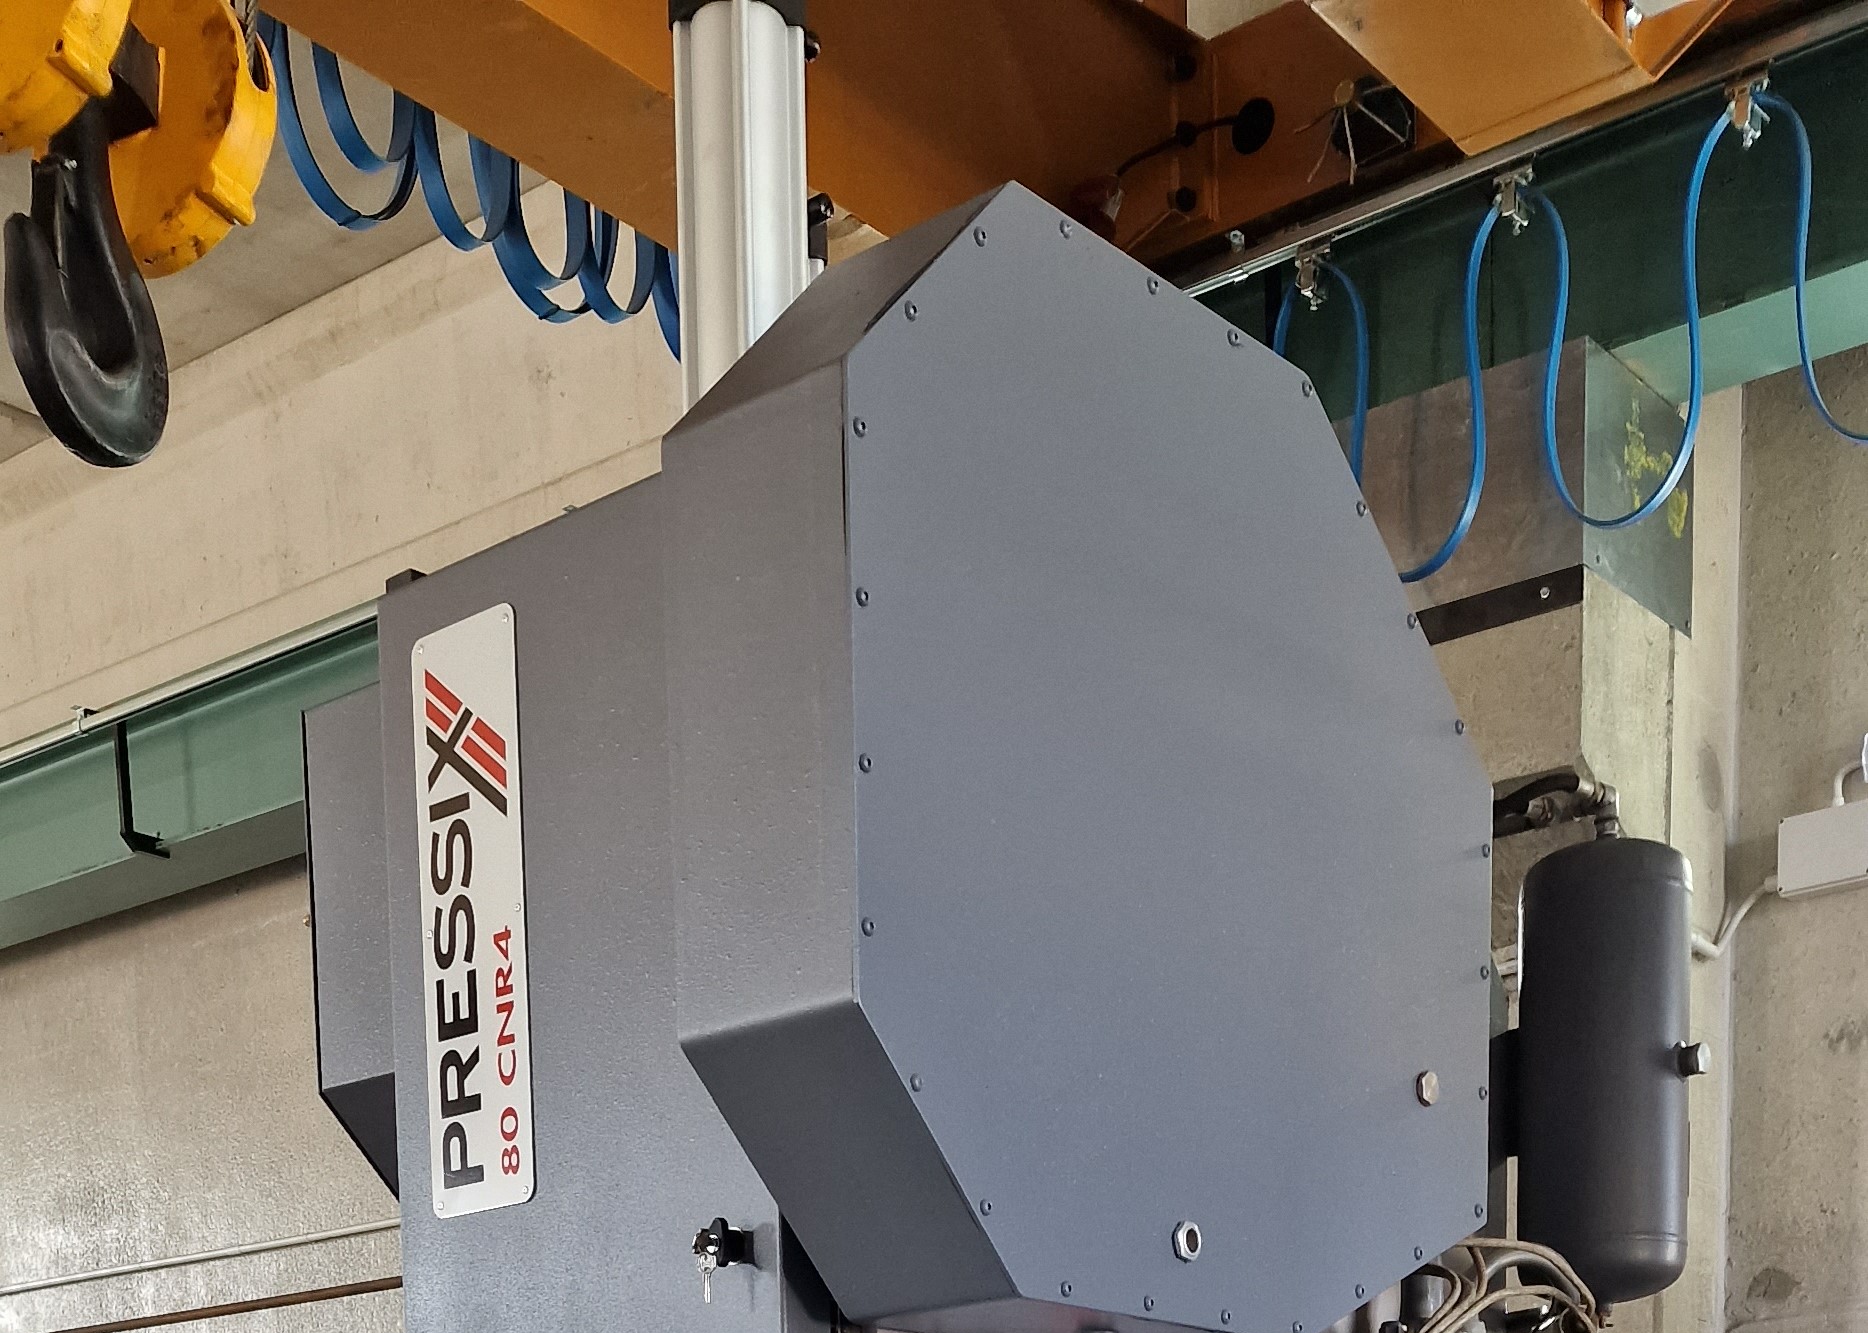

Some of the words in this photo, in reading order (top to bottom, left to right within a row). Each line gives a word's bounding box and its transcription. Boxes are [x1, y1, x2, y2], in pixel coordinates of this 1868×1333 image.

[424, 668, 509, 1190] PRESSIX
[492, 925, 519, 1087] CNR4
[500, 1106, 521, 1176] 80
